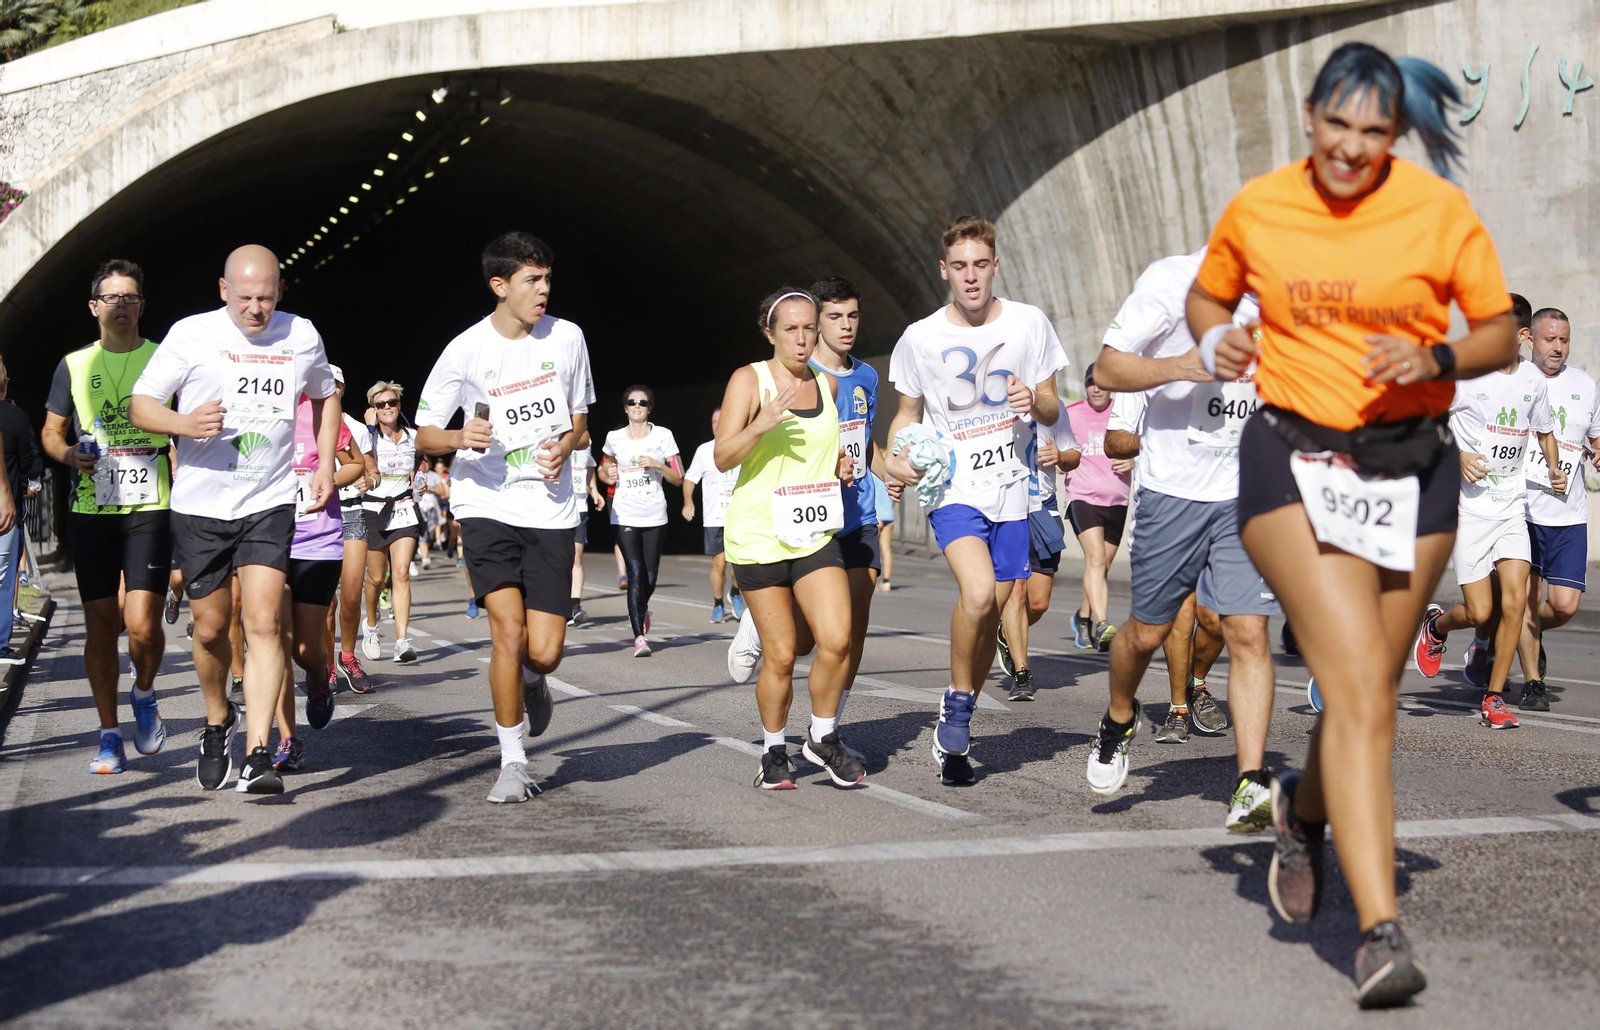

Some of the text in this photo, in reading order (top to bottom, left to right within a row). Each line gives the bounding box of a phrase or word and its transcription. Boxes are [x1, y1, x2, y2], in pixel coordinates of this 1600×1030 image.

[1285, 279, 1358, 303] YO SOY
[1290, 305, 1342, 327] BEER
[237, 376, 285, 396] 2140
[488, 371, 558, 398] 41 CARRERA URBANA
[941, 342, 1015, 411] 36
[506, 397, 556, 426] 9530
[1207, 397, 1258, 419] 6404
[953, 431, 967, 442] 41
[966, 423, 996, 435] CARRERA
[1486, 424, 1497, 433] 41
[1497, 425, 1520, 434] CARRERA
[970, 441, 1015, 471] 2217
[1082, 443, 1094, 456] 26
[1491, 444, 1523, 460] 1891
[109, 467, 149, 486] 1732
[787, 483, 815, 491] CARRERA
[816, 481, 839, 489] URBANA
[792, 504, 828, 524] 309
[1322, 486, 1393, 527] 9502
